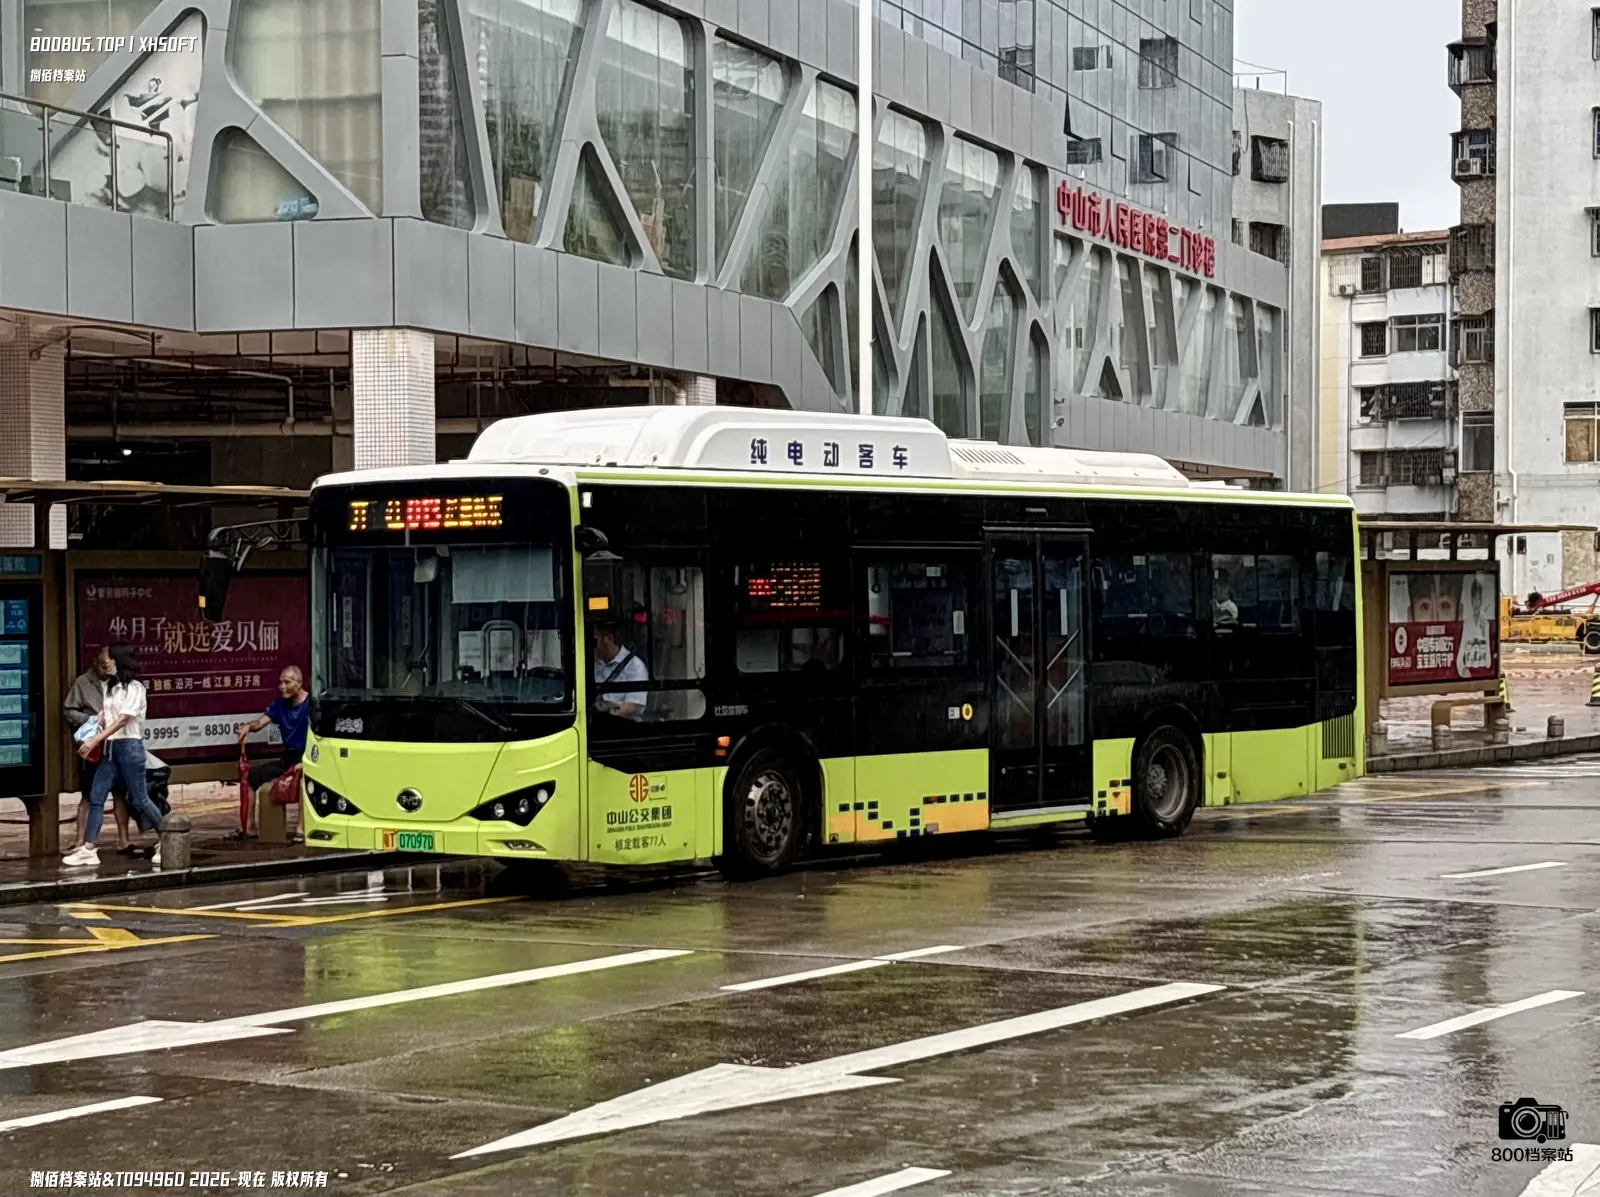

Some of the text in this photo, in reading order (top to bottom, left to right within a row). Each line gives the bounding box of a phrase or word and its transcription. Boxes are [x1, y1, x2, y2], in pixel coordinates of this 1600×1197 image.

[1056, 179, 1216, 278] 中山市人民医院第二门诊楼
[750, 438, 908, 470] 纯电动客车
[153, 726, 180, 740] 9995
[205, 722, 231, 737] 8830
[606, 805, 672, 825] 中山公交集团
